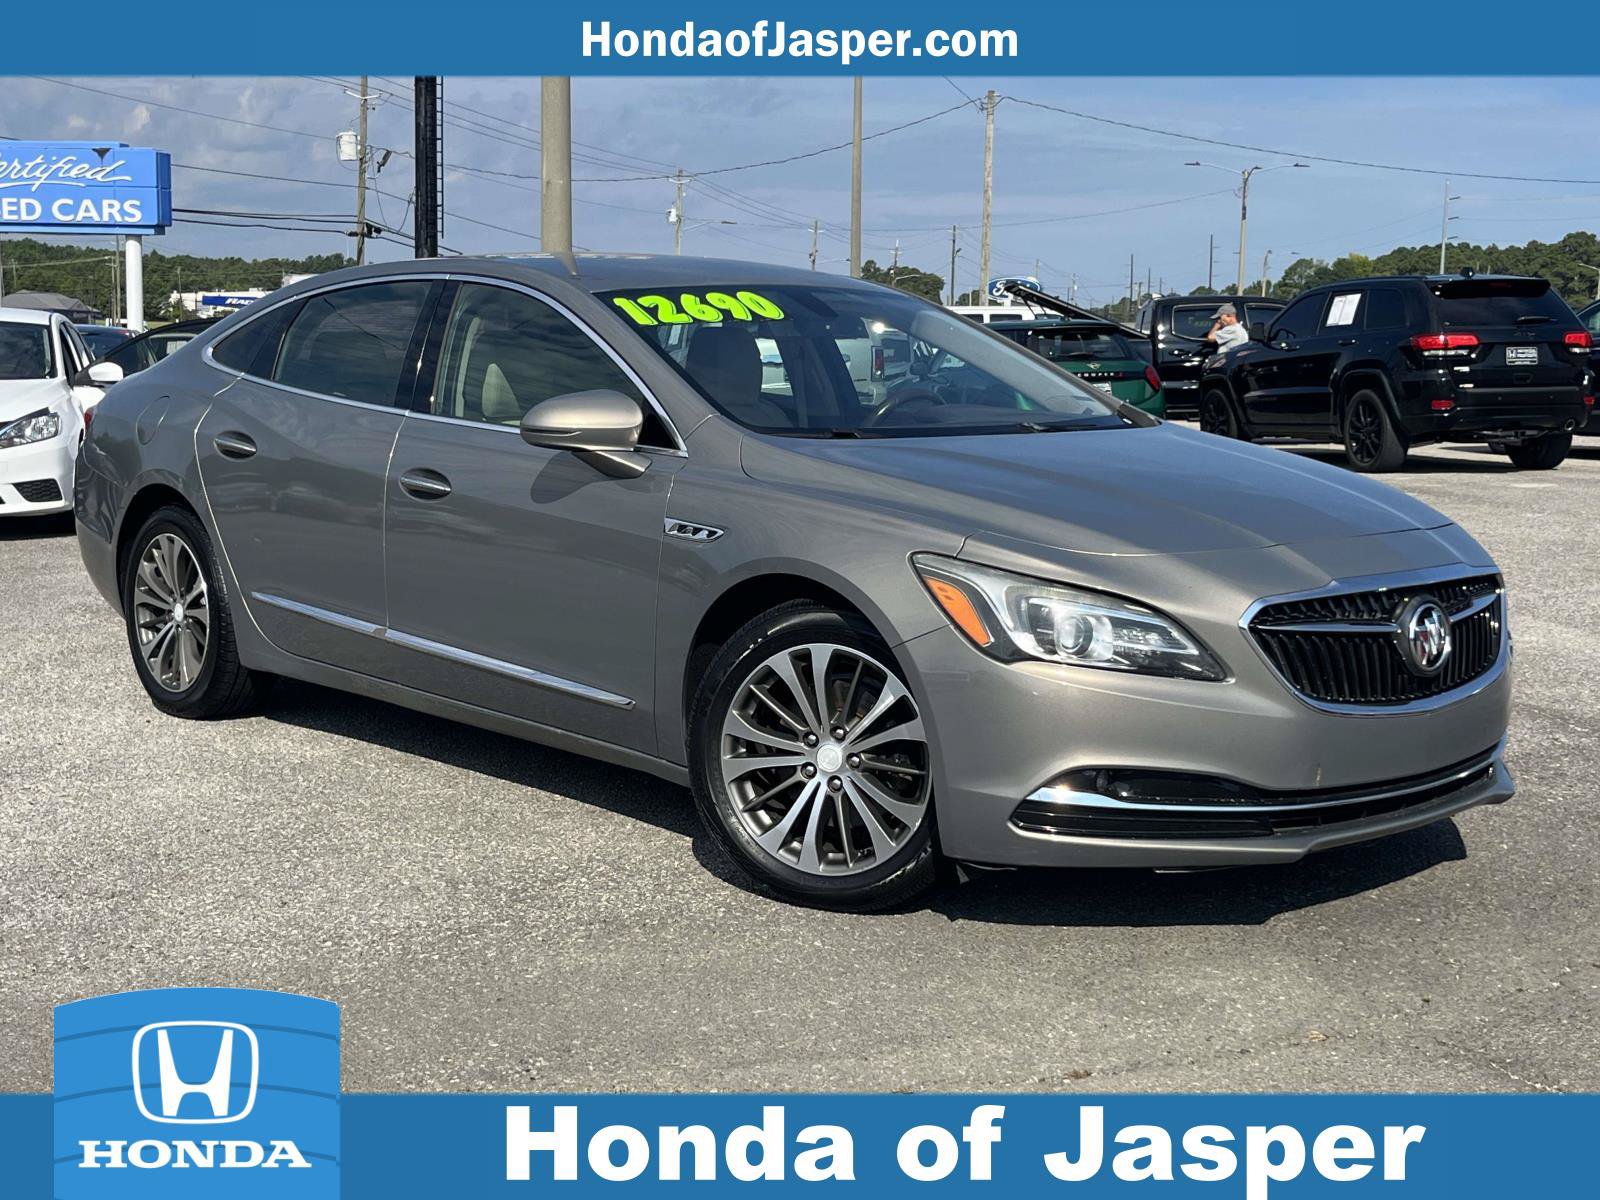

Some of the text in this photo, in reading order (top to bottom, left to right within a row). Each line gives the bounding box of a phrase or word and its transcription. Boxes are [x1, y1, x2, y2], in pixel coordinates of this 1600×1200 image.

[0, 155, 132, 192] ertified
[0, 198, 142, 223] ED CARS
[613, 291, 783, 326] 12690
